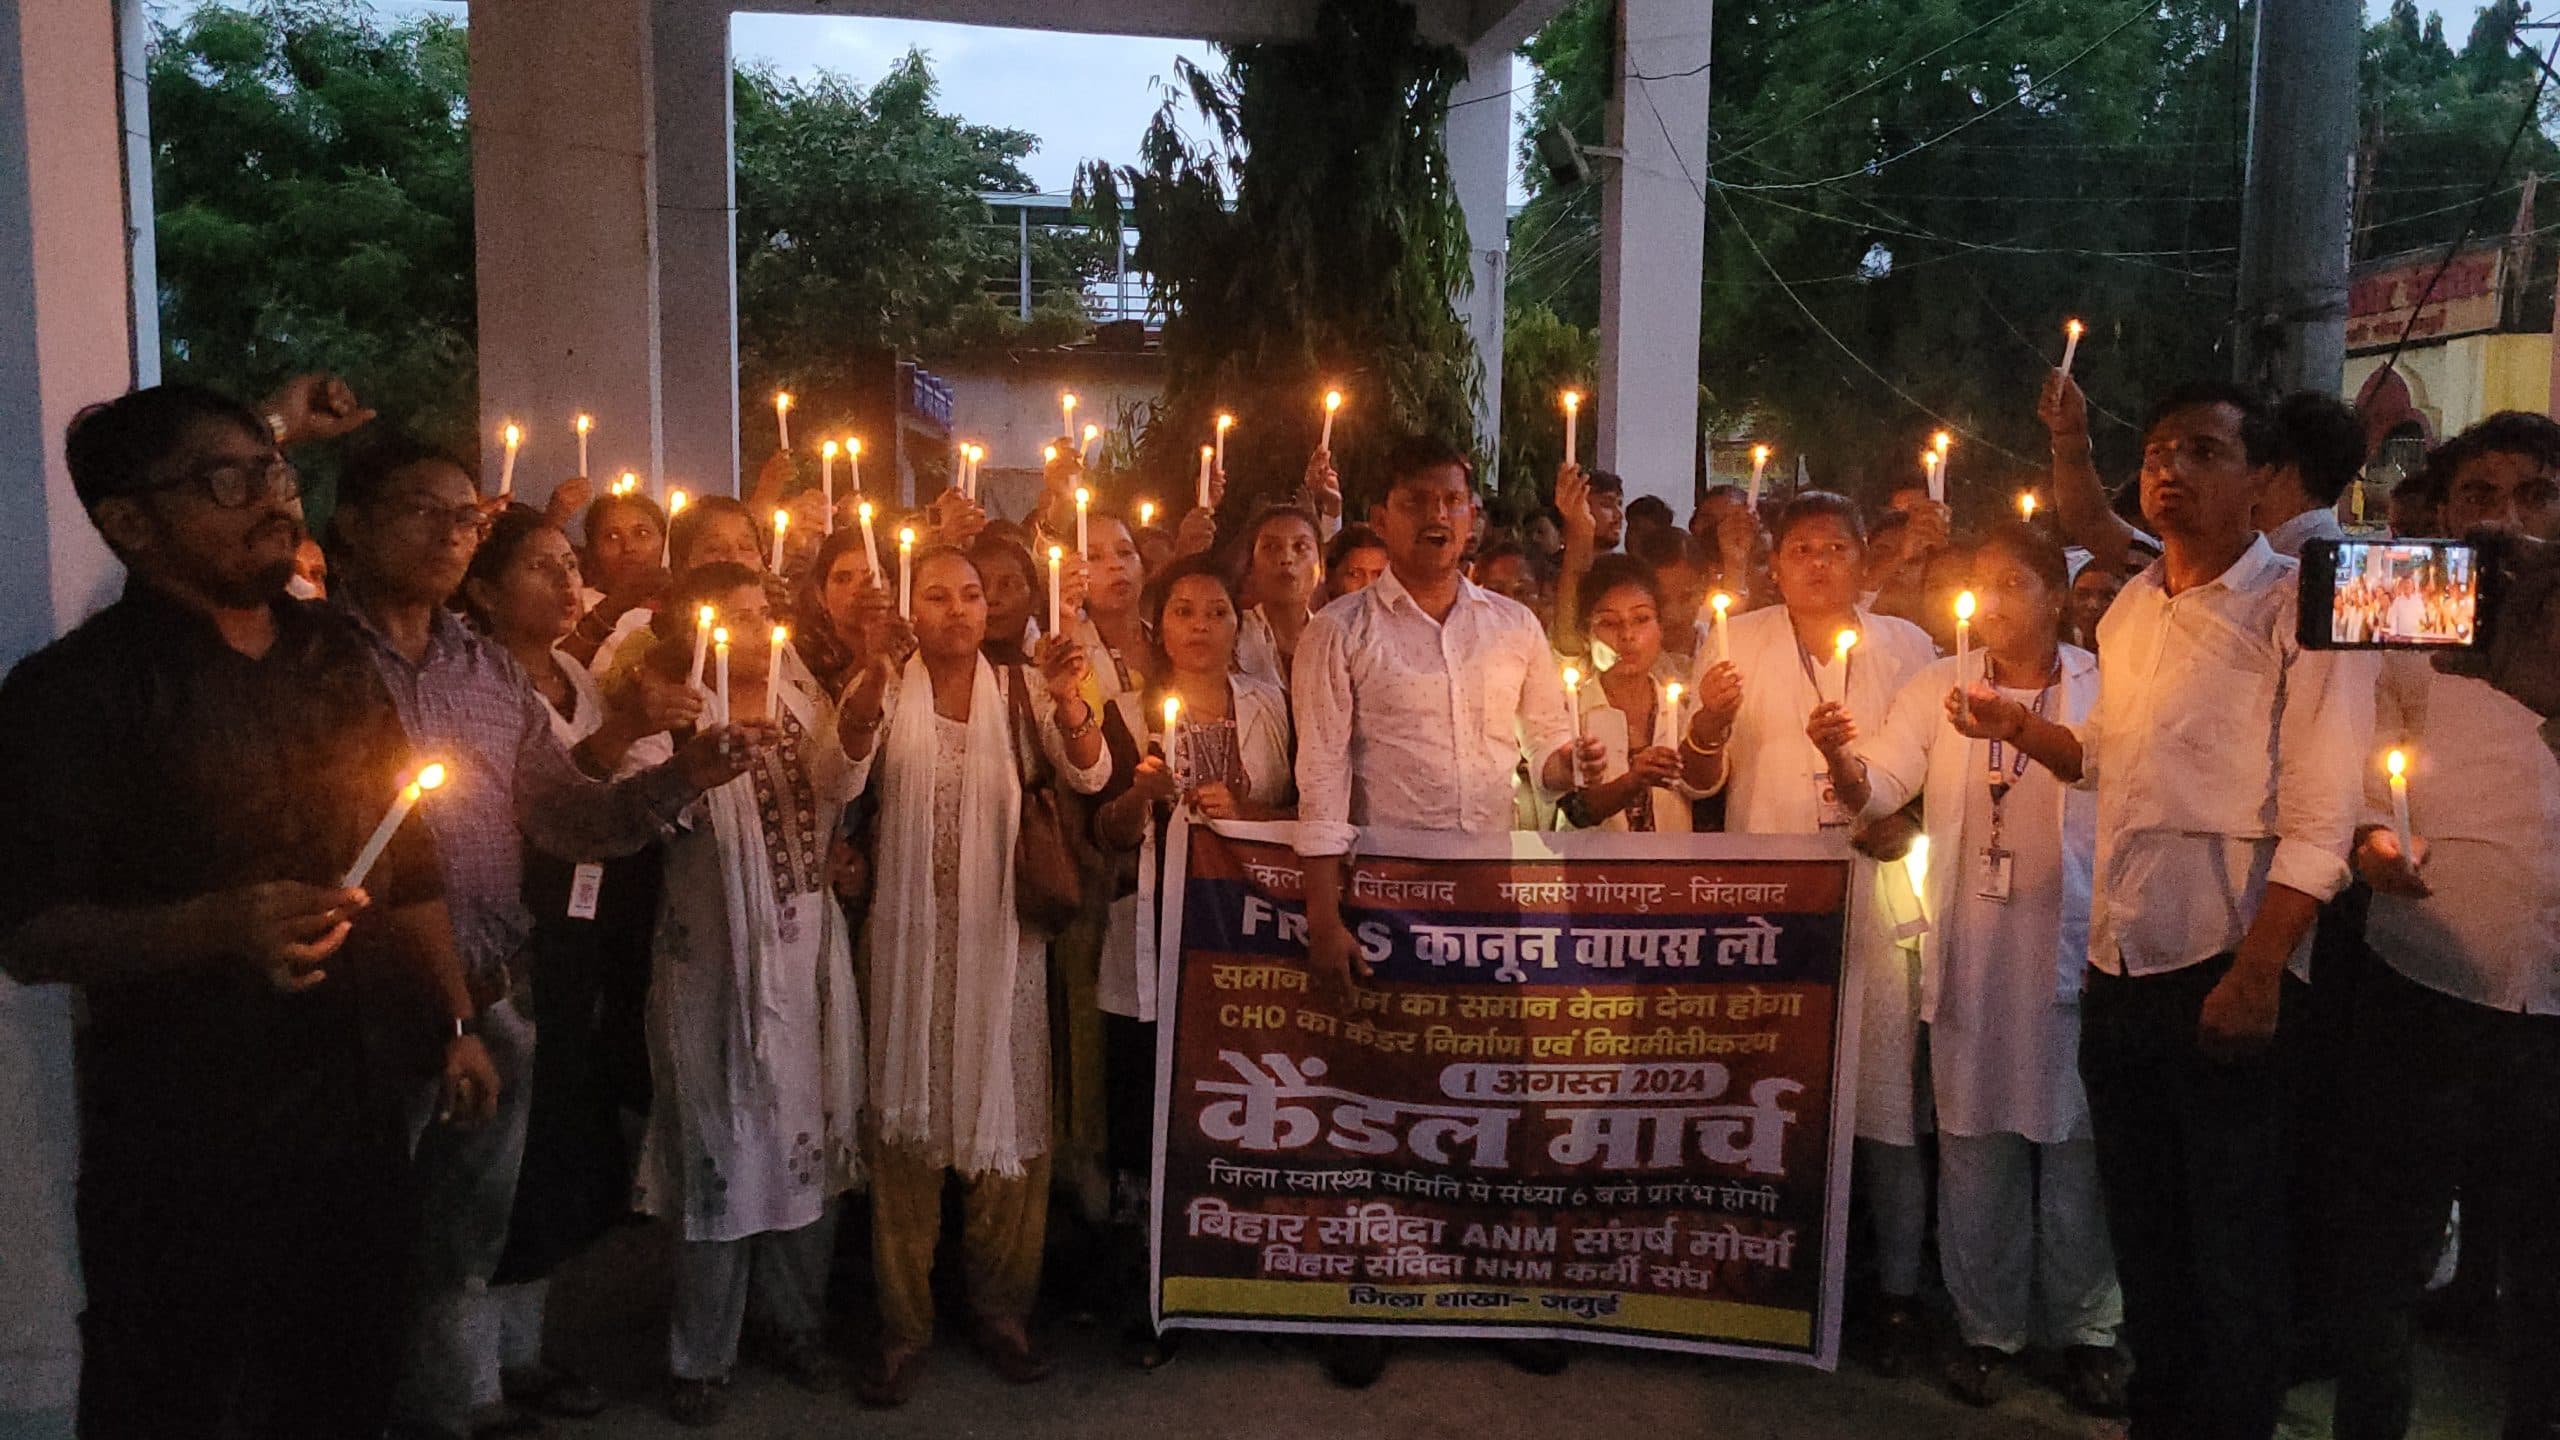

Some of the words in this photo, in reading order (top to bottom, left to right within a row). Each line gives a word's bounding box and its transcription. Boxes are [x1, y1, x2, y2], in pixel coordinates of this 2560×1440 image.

[1354, 870, 1456, 903] जिंदाबाद
[1498, 876, 1580, 907] महासंघ
[1584, 874, 1666, 912] गोपगुट
[1689, 876, 1788, 907] जिंदाबाद
[1242, 895, 1393, 962] FRS
[1409, 923, 1562, 983] कानून
[1570, 926, 1706, 969] वापस
[1714, 916, 1783, 966] लो
[1212, 963, 1310, 993] समान
[1400, 992, 1449, 1018] का
[1459, 993, 1561, 1020] समान
[1567, 986, 1648, 1020] वेतन
[1656, 986, 1717, 1020] देना
[1726, 985, 1803, 1021] होगा
[1220, 1004, 1287, 1030] CHO
[1296, 1009, 1337, 1038] का
[1424, 1025, 1522, 1057] निर्माण
[1531, 1028, 1580, 1057] एवं
[1463, 1069, 1477, 1094] 1
[1491, 1068, 1622, 1097] अगस्त
[1632, 1068, 1707, 1094] 2024
[1545, 1076, 1806, 1176] मार्च
[1208, 1157, 1280, 1190] जिला
[1285, 1167, 1374, 1193] स्वास्थ्य
[1381, 1171, 1462, 1200] समिति
[1466, 1176, 1490, 1202] से
[1499, 1180, 1567, 1206] संध्या
[1573, 1190, 1588, 1207] 6
[1595, 1178, 1641, 1207] बजे
[1648, 1178, 1715, 1207] प्रारंभ
[1719, 1178, 1781, 1214] होगी
[1186, 1196, 1310, 1244] बिहार
[1317, 1202, 1449, 1246] संविदा
[1461, 1222, 1558, 1253] ANM
[1572, 1215, 1681, 1256] संघर्ष
[1688, 1223, 1797, 1270] मोर्चा
[1262, 1243, 1358, 1277] बिहार
[1364, 1245, 1467, 1279] संविदा
[1475, 1256, 1554, 1281] NHM
[1564, 1253, 1642, 1286] कर्मी
[1650, 1259, 1714, 1292] संघ
[1349, 1282, 1428, 1309] जिला
